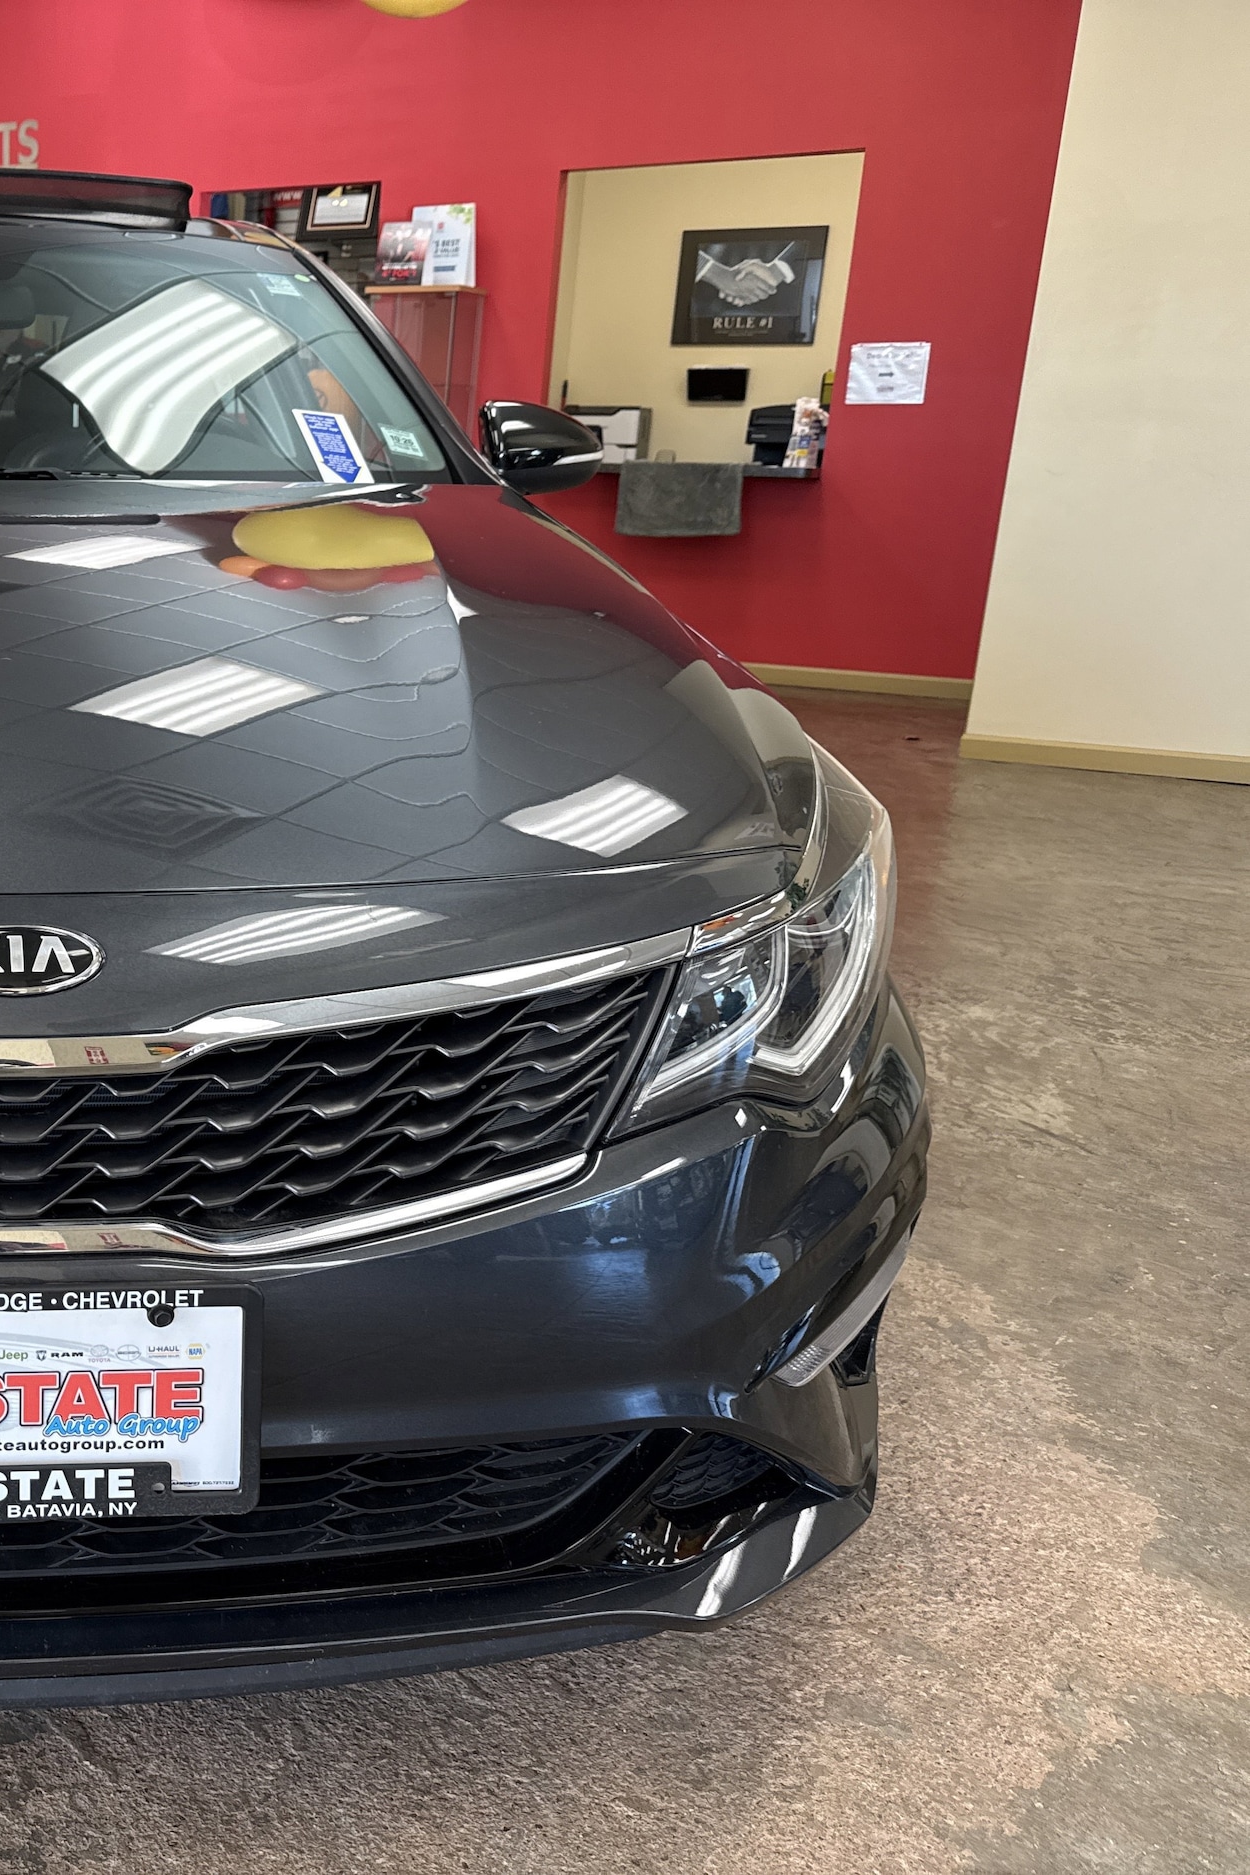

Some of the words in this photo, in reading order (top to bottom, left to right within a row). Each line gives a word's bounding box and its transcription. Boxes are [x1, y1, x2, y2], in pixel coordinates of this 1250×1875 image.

[712, 316, 756, 329] RULE
[759, 316, 774, 329] #1
[62, 1289, 204, 1310] CHEVROLET
[188, 1348, 203, 1356] NAPA
[44, 1414, 111, 1437] Auto
[118, 1413, 200, 1442] Group
[7, 1503, 104, 1519] BATAVIA,
[109, 1502, 138, 1516] NY
